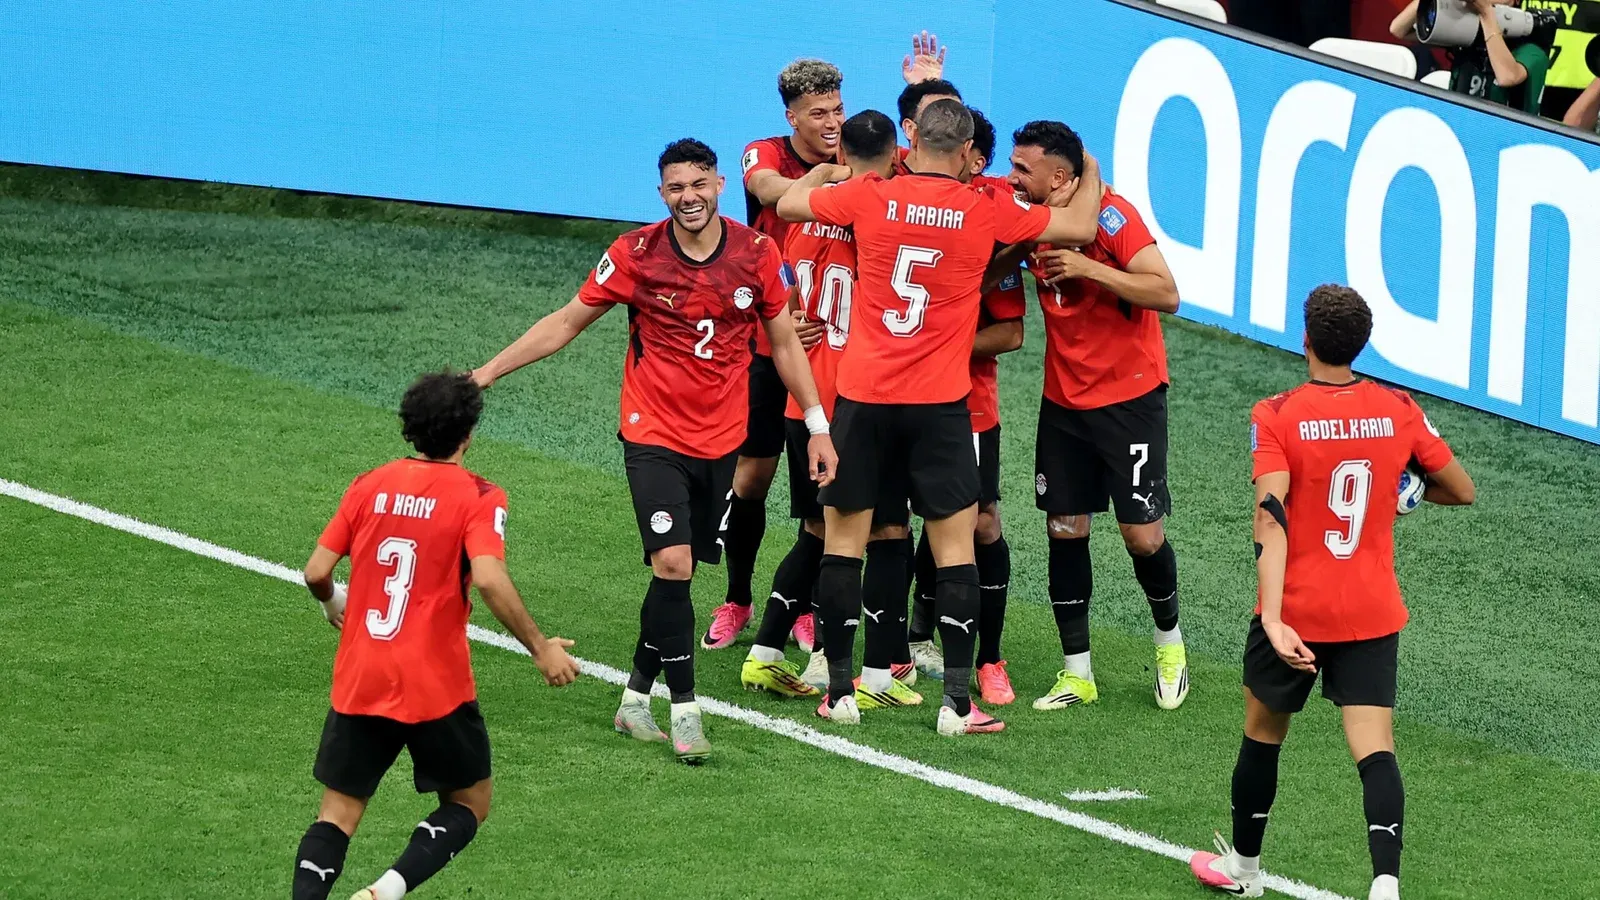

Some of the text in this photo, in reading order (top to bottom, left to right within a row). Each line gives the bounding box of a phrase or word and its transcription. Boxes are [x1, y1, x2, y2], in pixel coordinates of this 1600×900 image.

[886, 200, 965, 229] R. RABIAA
[882, 244, 944, 338] 5
[694, 319, 715, 360] 2
[1299, 417, 1395, 441] ABDELKARIM
[1129, 443, 1149, 487] 7
[373, 492, 437, 519] M. HANY
[1324, 459, 1373, 560] 9
[365, 536, 418, 641] 3
